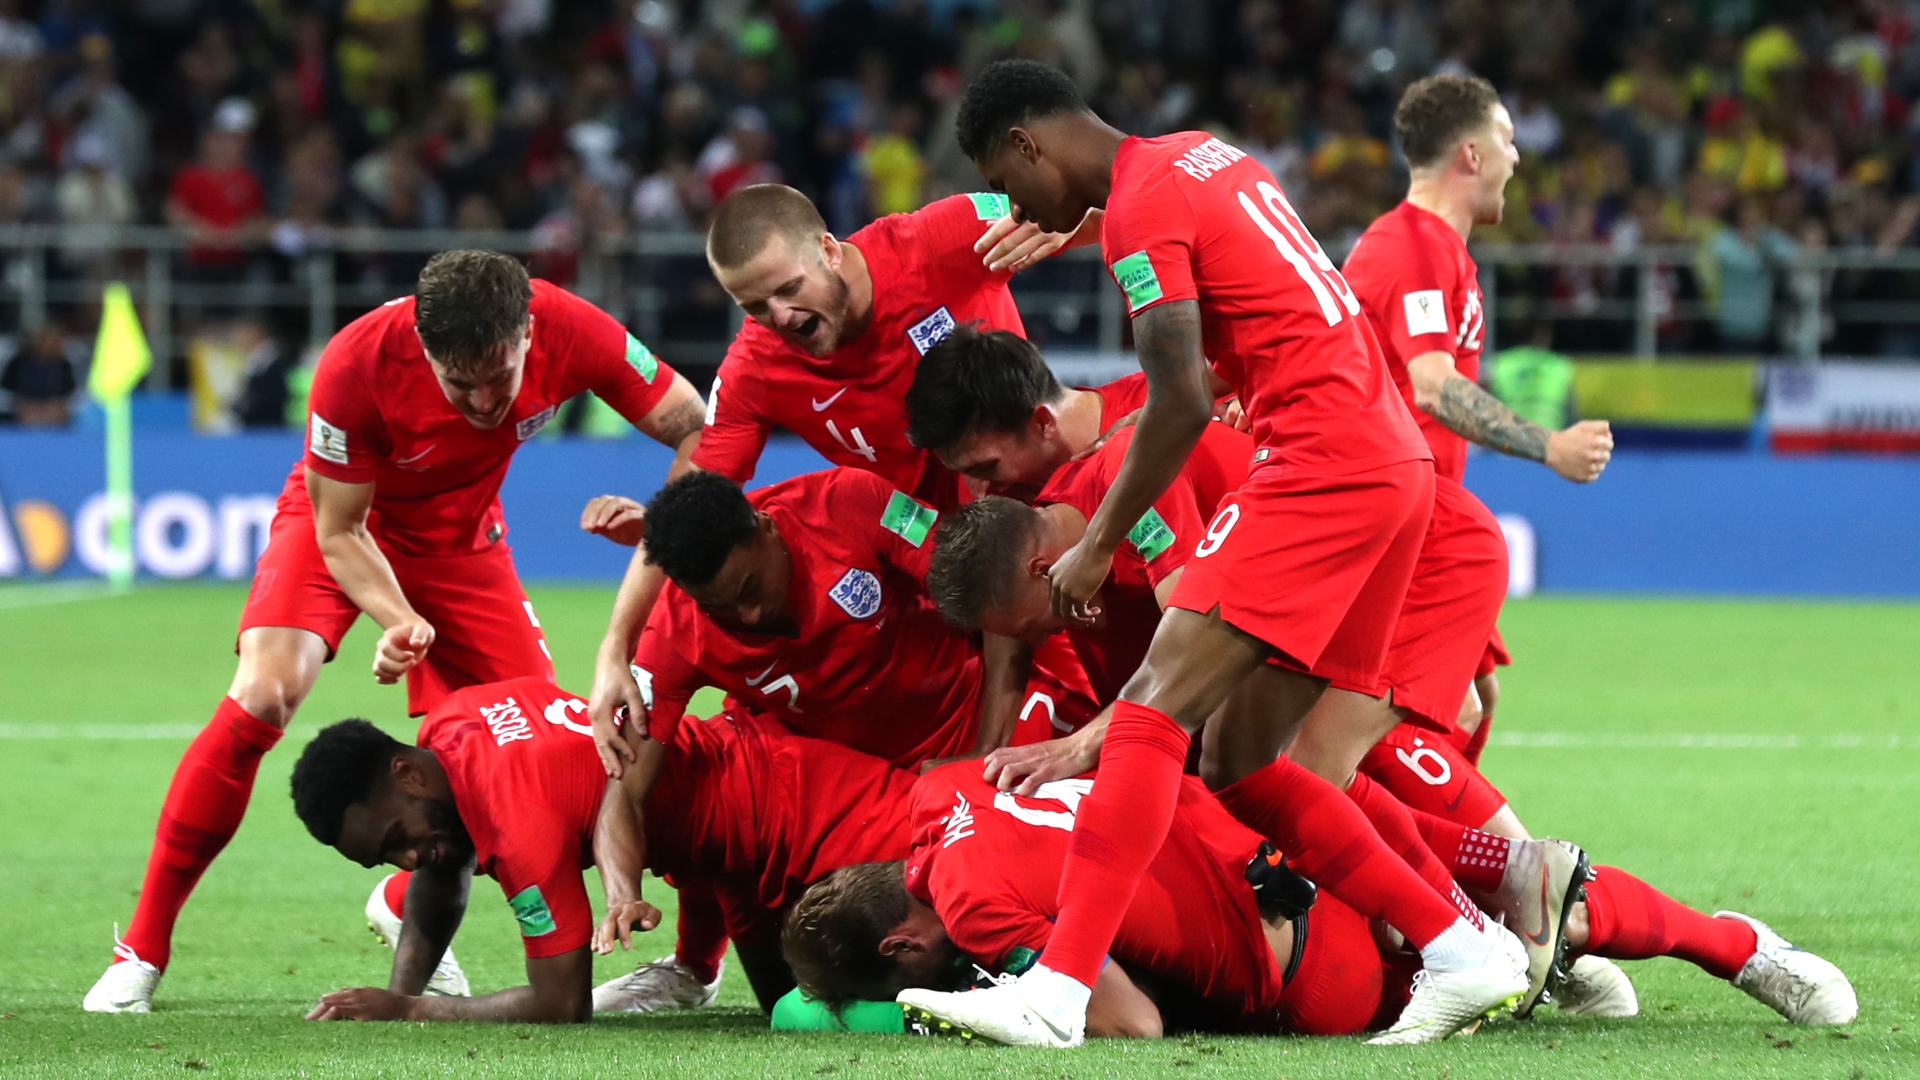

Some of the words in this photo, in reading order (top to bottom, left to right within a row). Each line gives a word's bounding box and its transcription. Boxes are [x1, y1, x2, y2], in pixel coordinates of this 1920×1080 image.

[1237, 181, 1361, 328] 19
[1456, 289, 1483, 350] 12
[825, 419, 877, 462] 4
[1153, 529, 1168, 541] FIFA
[1195, 503, 1240, 558] 9
[760, 674, 804, 713] 7
[1019, 691, 1074, 733] 7
[479, 697, 534, 747] ROSE
[1396, 737, 1452, 785] 6
